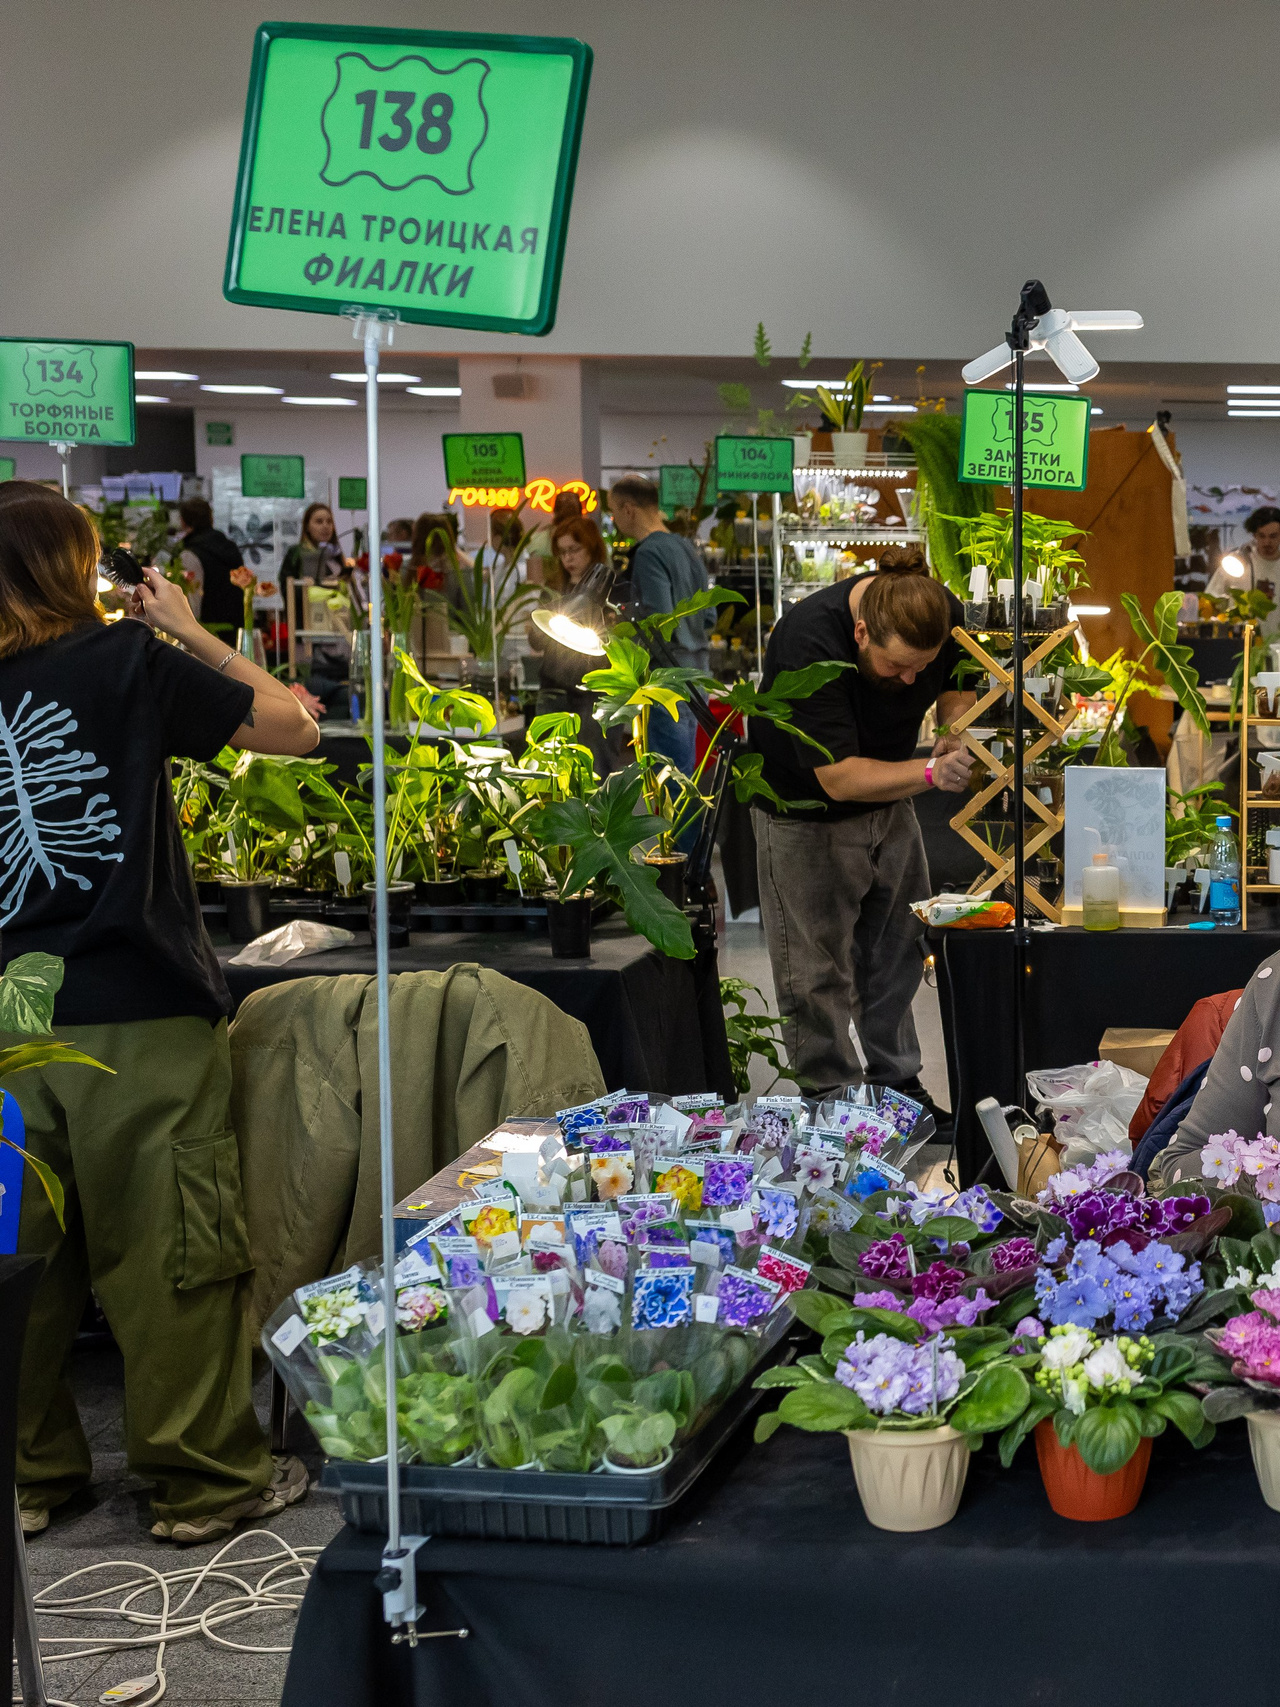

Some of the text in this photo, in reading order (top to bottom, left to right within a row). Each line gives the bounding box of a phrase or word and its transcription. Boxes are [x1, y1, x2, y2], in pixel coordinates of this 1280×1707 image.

[355, 89, 455, 155] 138
[248, 206, 540, 255] ЕЛЕНА ТРОИЦКАЯ
[303, 252, 475, 299] ФИАЛКИ
[36, 359, 84, 383] 134
[9, 402, 114, 421] ТОРФЯНЫЕ
[24, 421, 101, 438] БОЛОТА
[472, 443, 498, 457] 105
[741, 447, 768, 461] 104
[984, 448, 1060, 467] ЗАМЕТКИ
[967, 462, 1075, 484] ЗЕЛЕНОЛОГА
